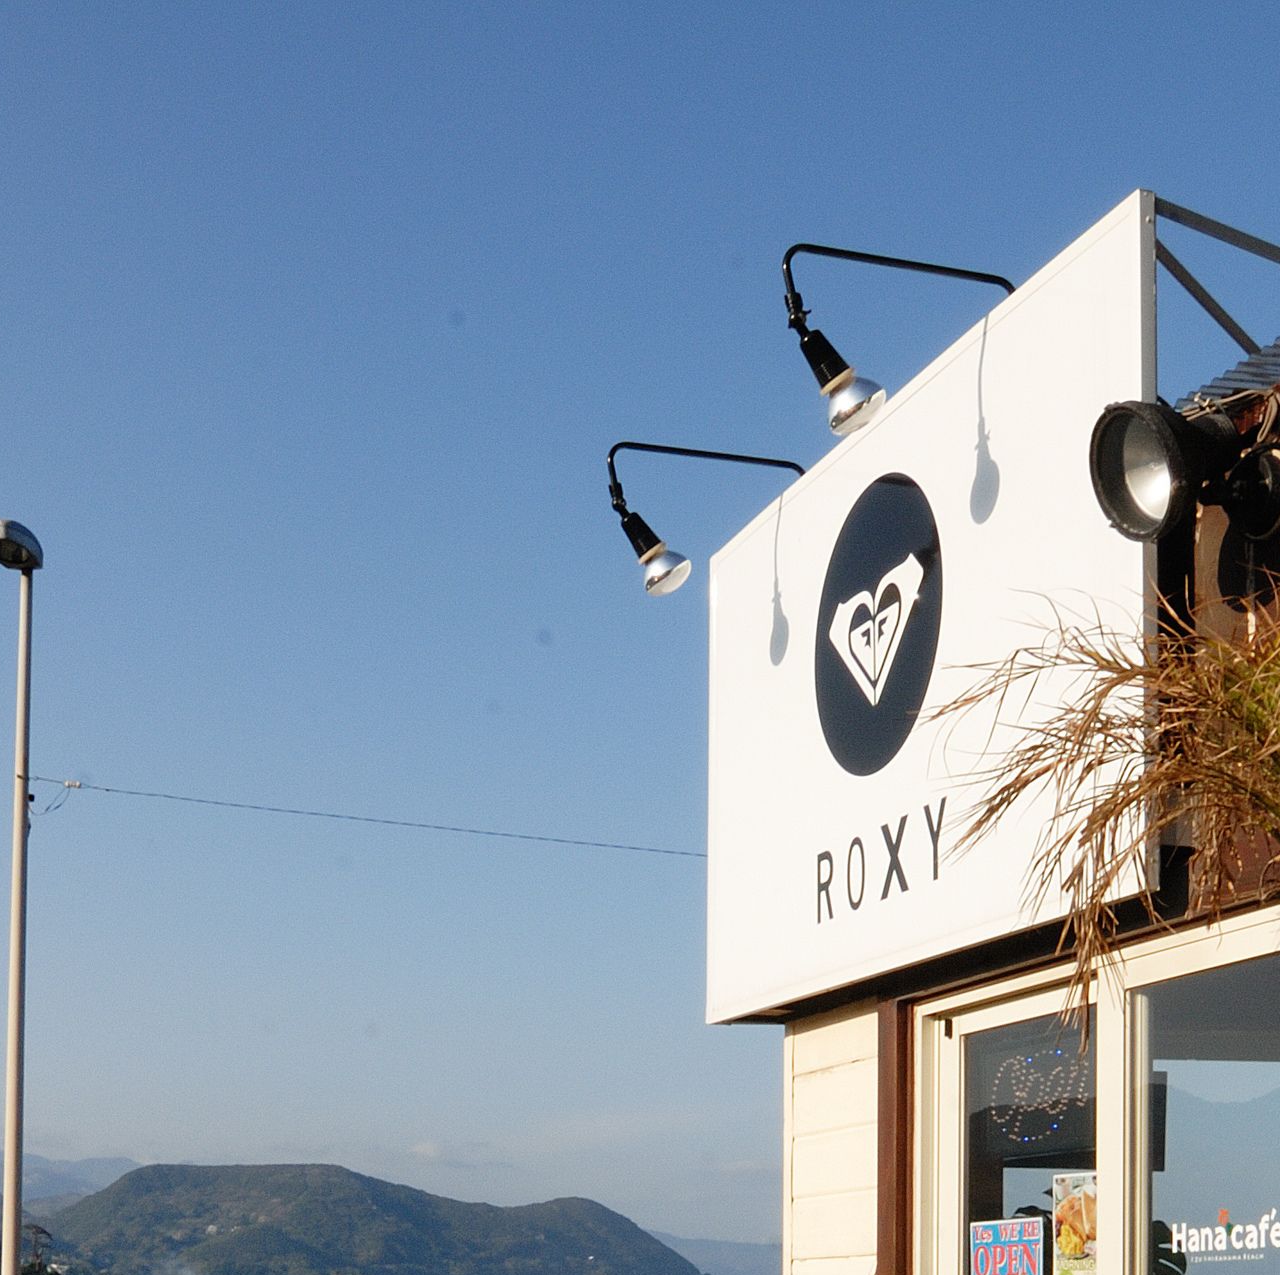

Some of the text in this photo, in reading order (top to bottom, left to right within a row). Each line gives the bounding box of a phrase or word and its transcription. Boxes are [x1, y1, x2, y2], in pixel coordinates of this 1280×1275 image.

[817, 797, 948, 924] ROXY
[974, 1226, 993, 1242] Yes
[1171, 1222, 1227, 1253] Hana
